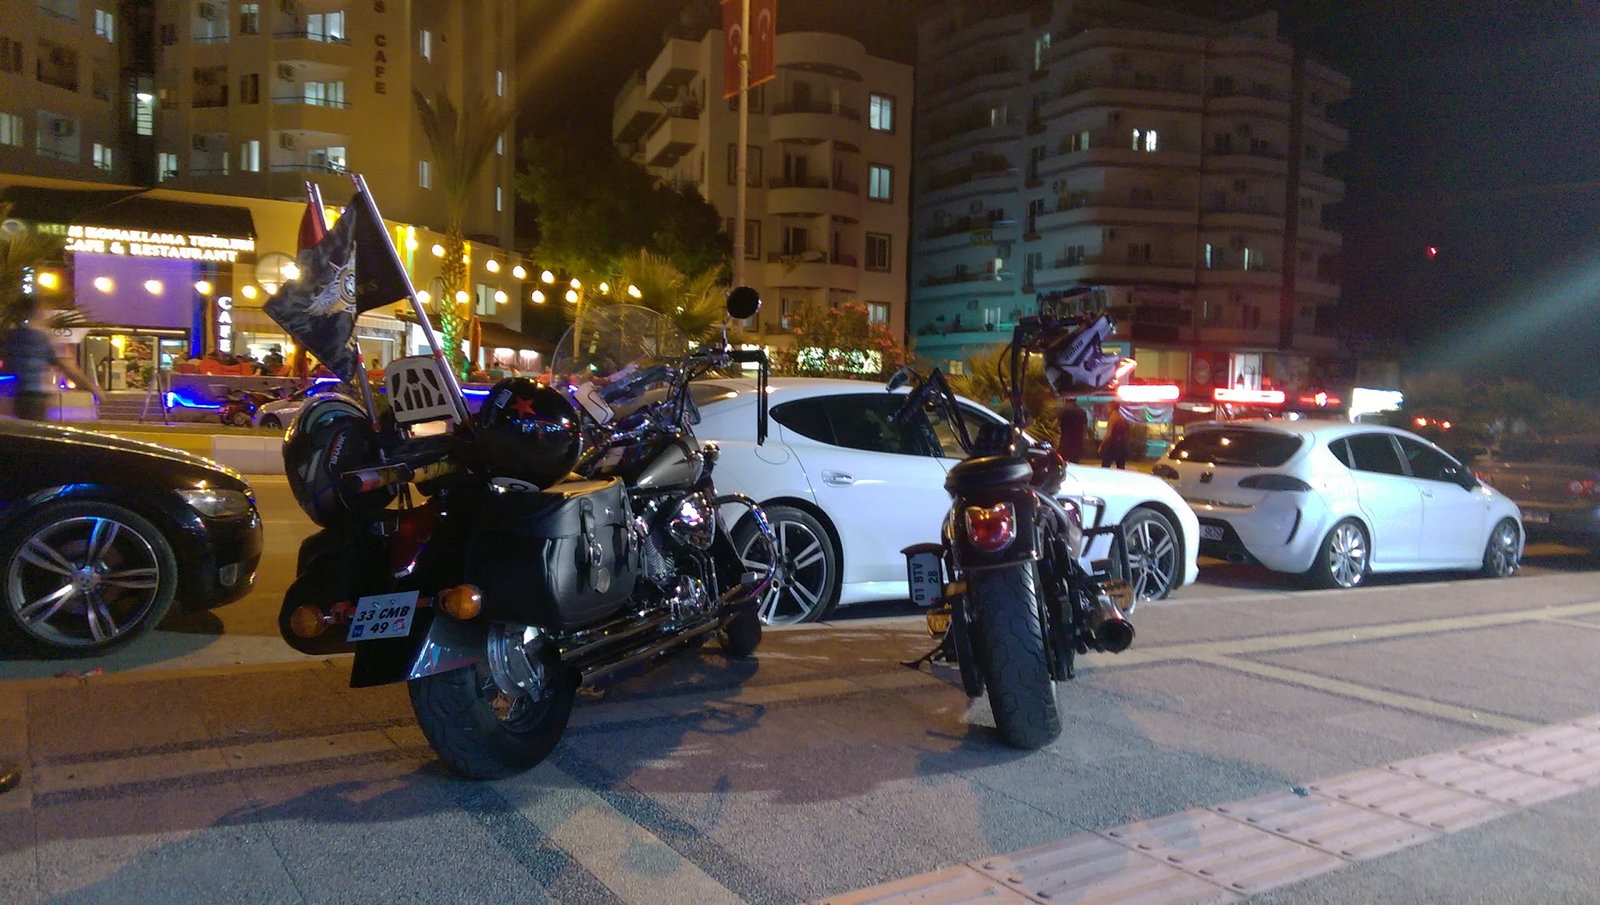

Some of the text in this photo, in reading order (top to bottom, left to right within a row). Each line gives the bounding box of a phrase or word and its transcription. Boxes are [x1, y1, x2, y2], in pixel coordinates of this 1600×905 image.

[374, 34, 387, 95] CAFE
[85, 227, 186, 245] KONAKLAMA
[65, 238, 238, 262] CAFE & RESTAURANT
[217, 296, 233, 353] CAFE
[912, 563, 925, 600] 01 BTV
[928, 570, 939, 584] 28
[357, 606, 411, 622] 33 CMB
[369, 621, 389, 634] 49
